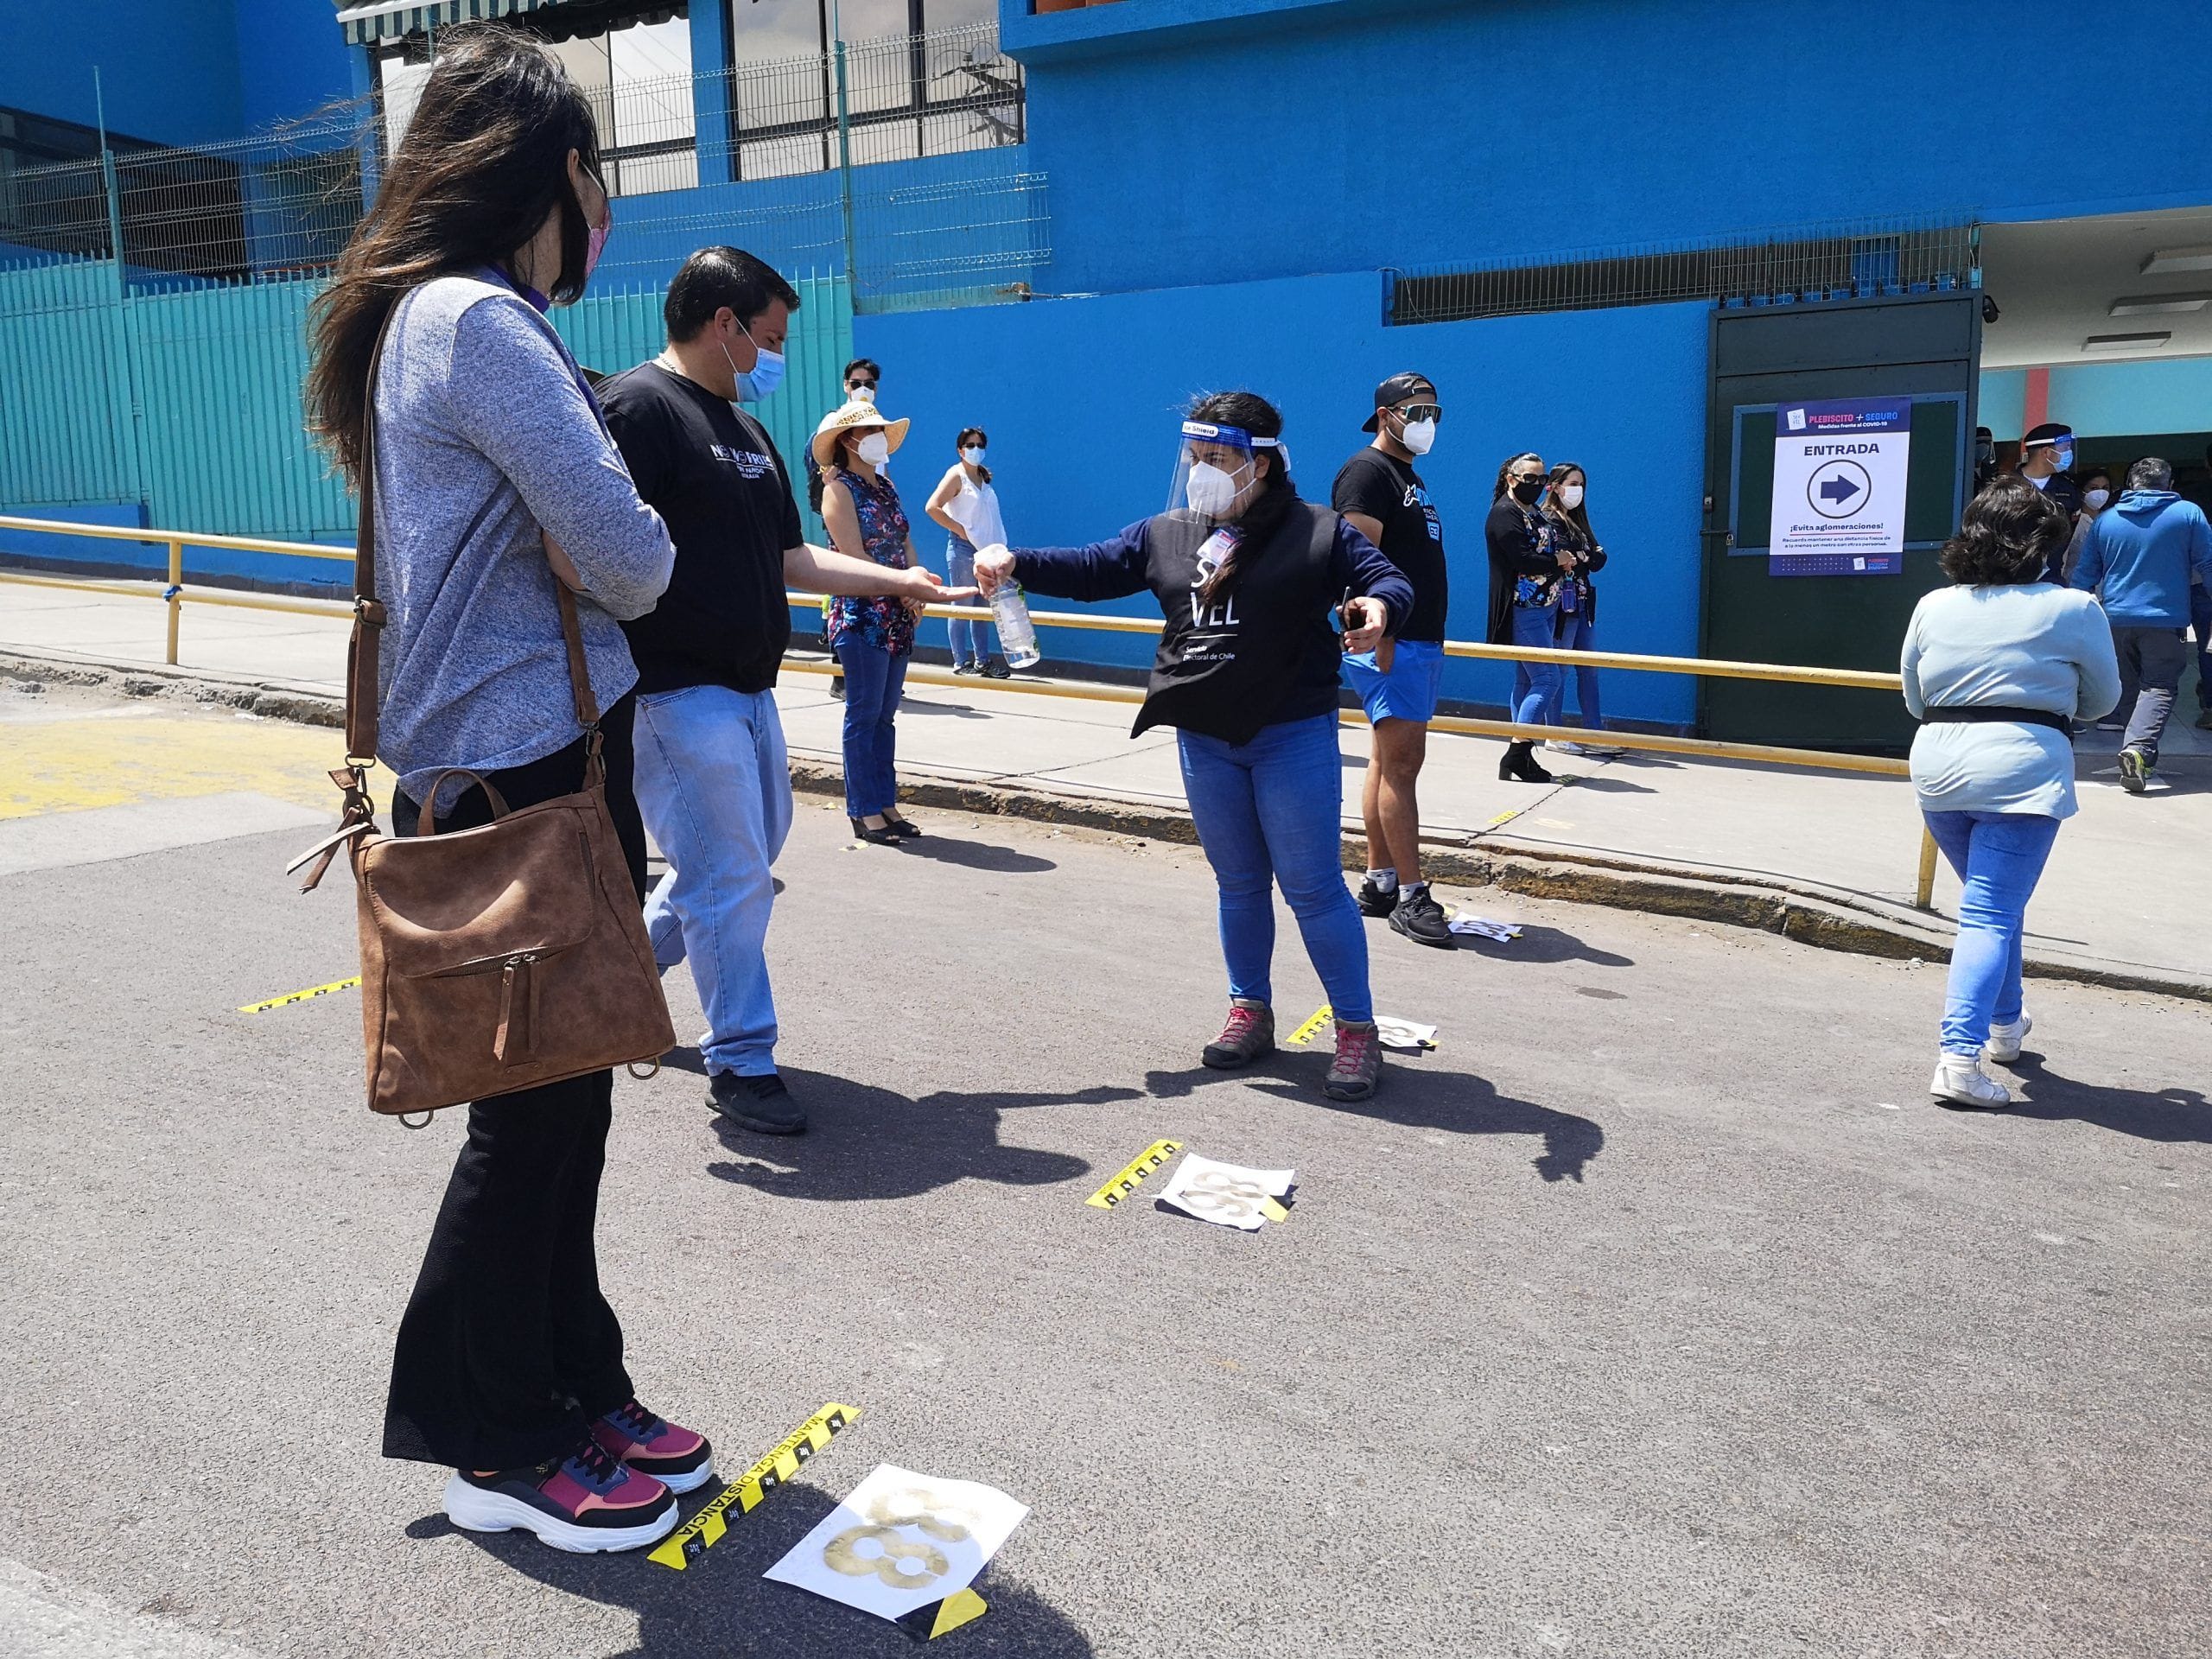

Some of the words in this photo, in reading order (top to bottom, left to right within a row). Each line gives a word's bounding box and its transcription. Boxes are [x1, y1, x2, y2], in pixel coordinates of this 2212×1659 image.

[1809, 414, 1854, 423] PLEBISCITO
[1865, 412, 1898, 422] SEGURO
[1804, 443, 1880, 456] ENTRADA
[1815, 523, 1884, 532] aglomeraciones!
[752, 1415, 823, 1474] MANTENGA
[677, 1475, 755, 1536] DISTANCIA
